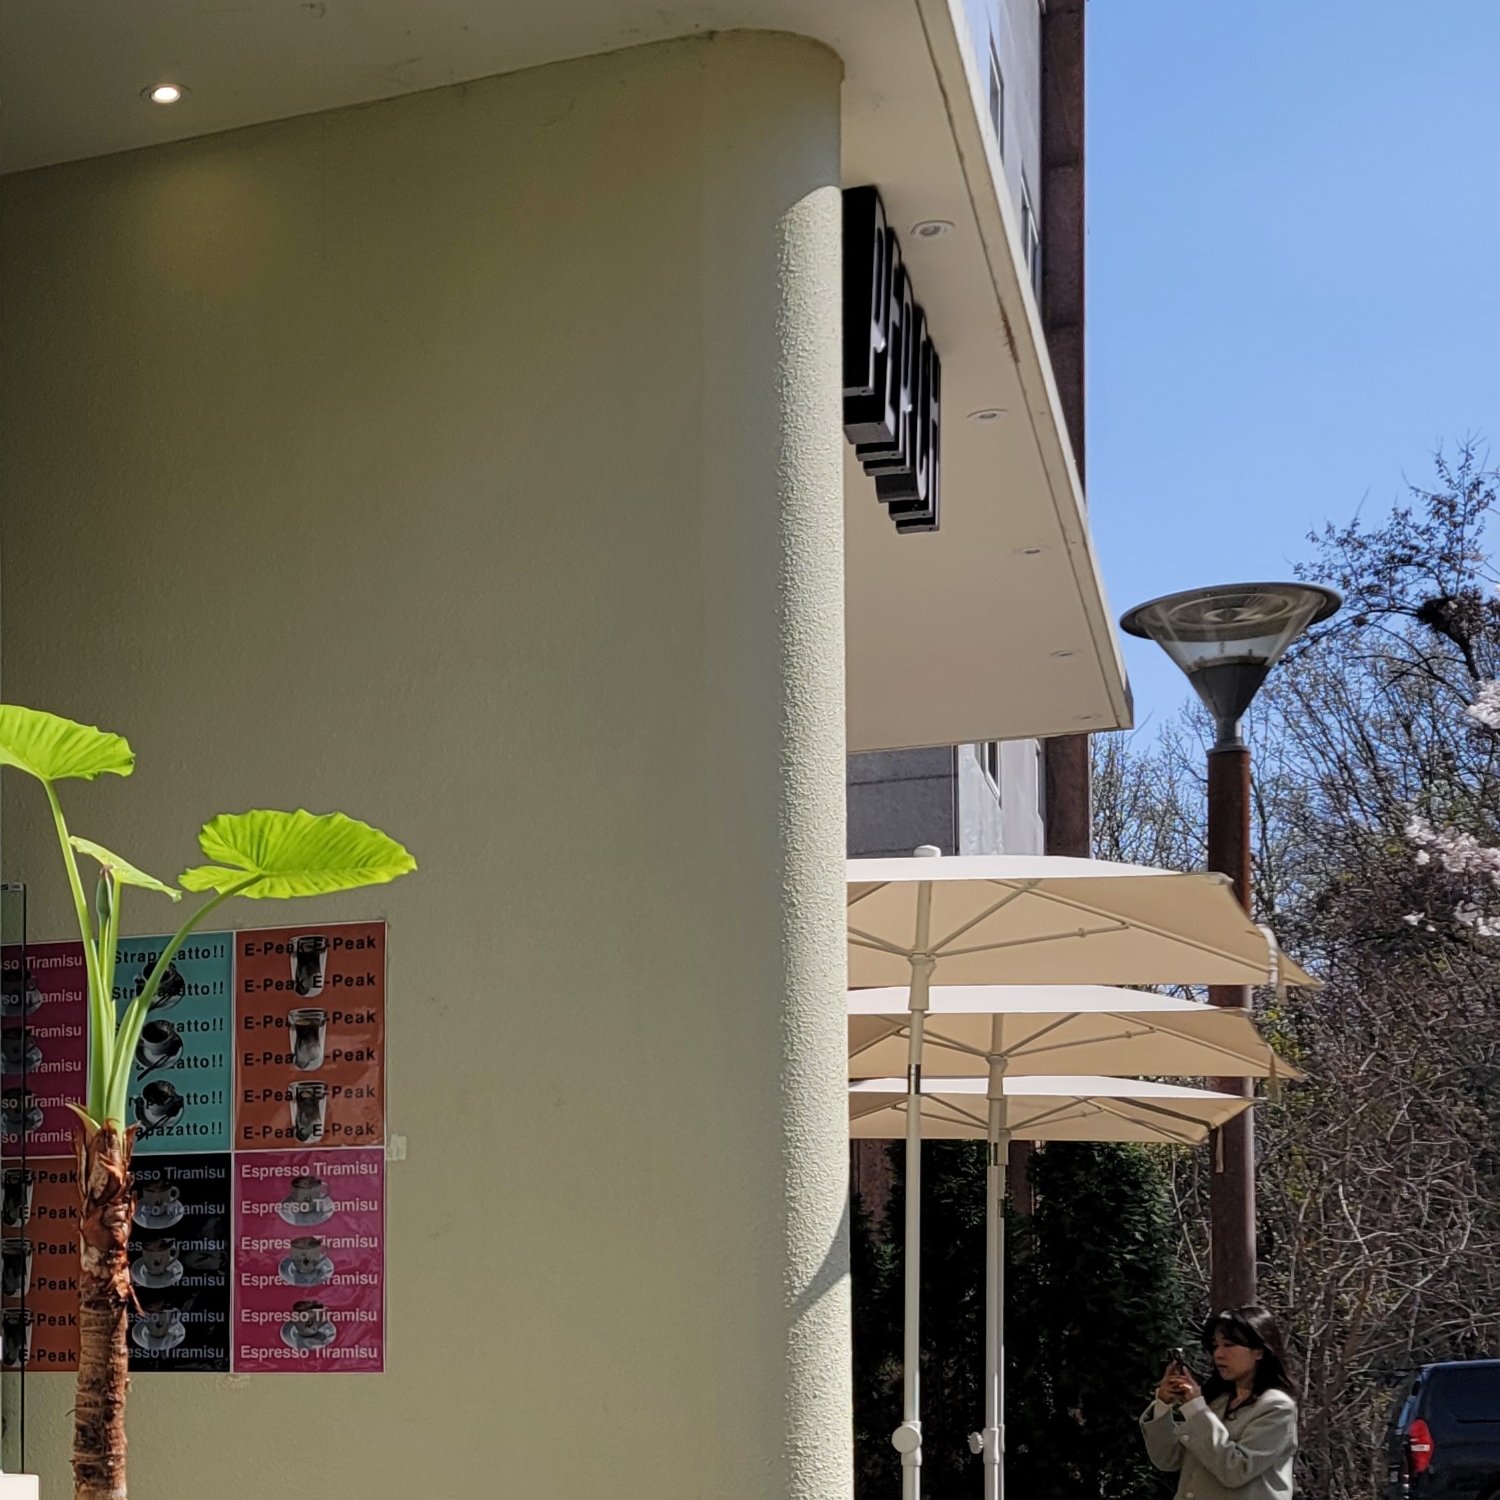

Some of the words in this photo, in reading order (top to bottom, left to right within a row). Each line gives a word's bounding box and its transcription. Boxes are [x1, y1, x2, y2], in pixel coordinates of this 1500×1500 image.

[25, 953, 83, 969] Tiramisu
[115, 944, 224, 964] Strapatto!!
[244, 977, 304, 993] E-Peak
[313, 972, 376, 988] E-Peak
[25, 988, 82, 1004] Tamisu
[244, 1014, 290, 1030] E-Pe
[327, 1010, 376, 1025] -Peak
[244, 1051, 294, 1067] E-Pea
[325, 1047, 375, 1062] -Peak
[32, 1059, 81, 1074] ramisu
[25, 1129, 76, 1144] Tiramis
[135, 1121, 222, 1140] apazatto!!
[313, 1121, 375, 1137] E-Peak
[164, 1165, 226, 1179] Tiramisu
[241, 1164, 310, 1181] Espresso
[313, 1160, 378, 1176] Tiramisu
[164, 1202, 225, 1215] Tamisu
[241, 1200, 310, 1217] Espresso
[32, 1241, 77, 1255] -Peak
[241, 1236, 292, 1253] Espres
[30, 1277, 77, 1291] -Peak
[172, 1272, 225, 1287] ramisu
[241, 1272, 289, 1289] Espre
[323, 1271, 378, 1285] ramisu
[241, 1309, 310, 1326] Espresso
[312, 1307, 378, 1322] Tiramisu
[241, 1345, 310, 1362] Espresso
[312, 1344, 378, 1359] Tiramisu
